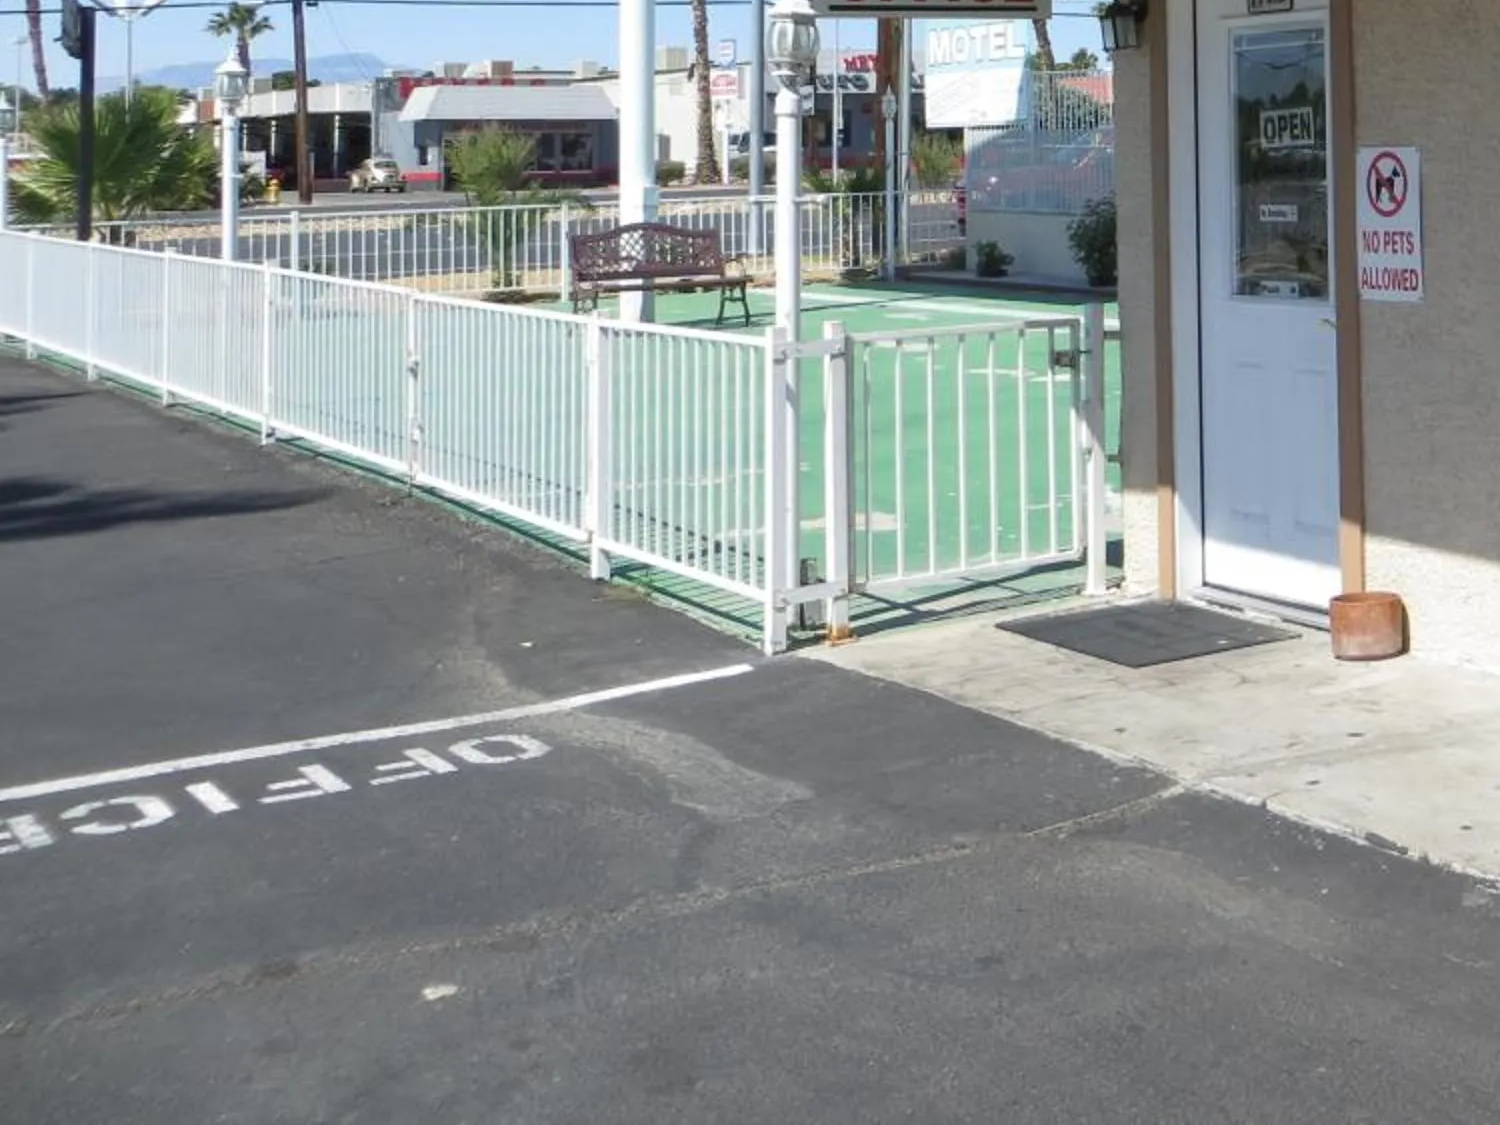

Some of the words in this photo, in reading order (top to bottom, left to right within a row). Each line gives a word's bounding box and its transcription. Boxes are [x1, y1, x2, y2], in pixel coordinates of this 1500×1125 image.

[928, 21, 1025, 66] MOTEL
[1263, 113, 1311, 144] OPEN
[1362, 230, 1380, 254] NO
[1383, 230, 1414, 255] PETS
[1361, 268, 1419, 292] ALLOWED
[0, 733, 554, 855] OFFICE
